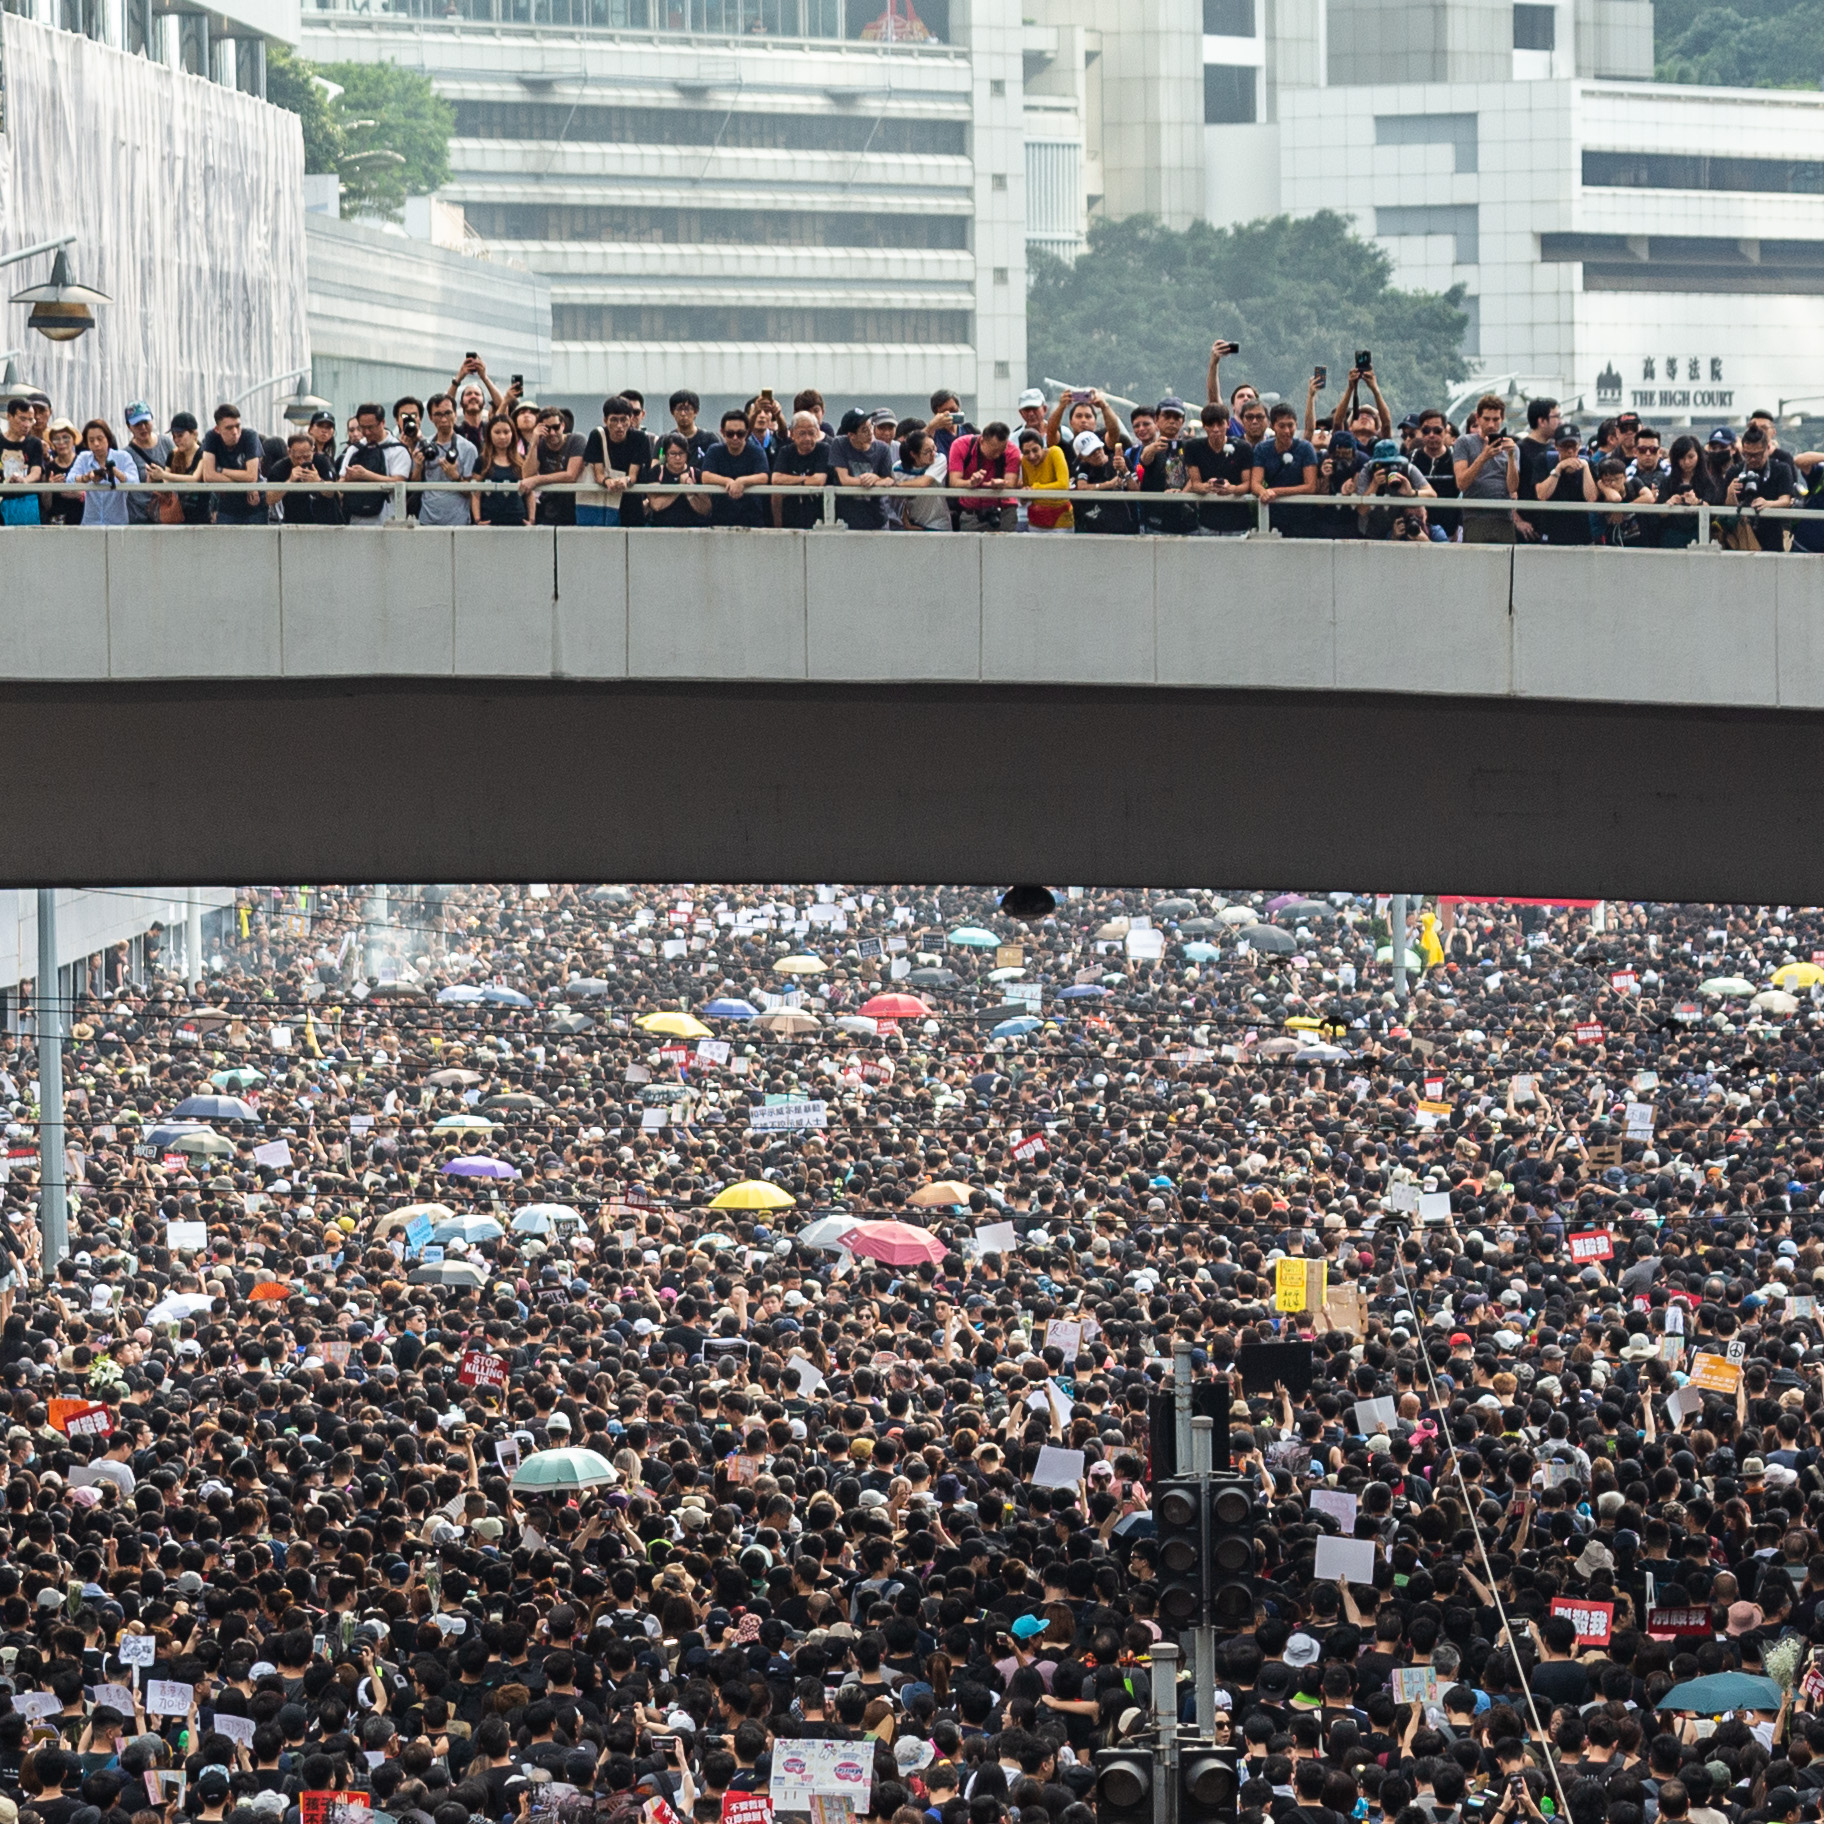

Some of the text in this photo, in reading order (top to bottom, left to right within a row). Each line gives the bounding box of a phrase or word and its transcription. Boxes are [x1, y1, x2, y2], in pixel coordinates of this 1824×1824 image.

[1643, 356, 1723, 381] 高等法院
[1631, 389, 1735, 408] THE HIGH COURT
[464, 1361, 503, 1380] KILLING
[473, 1353, 500, 1369] STOP
[475, 1372, 490, 1385] US
